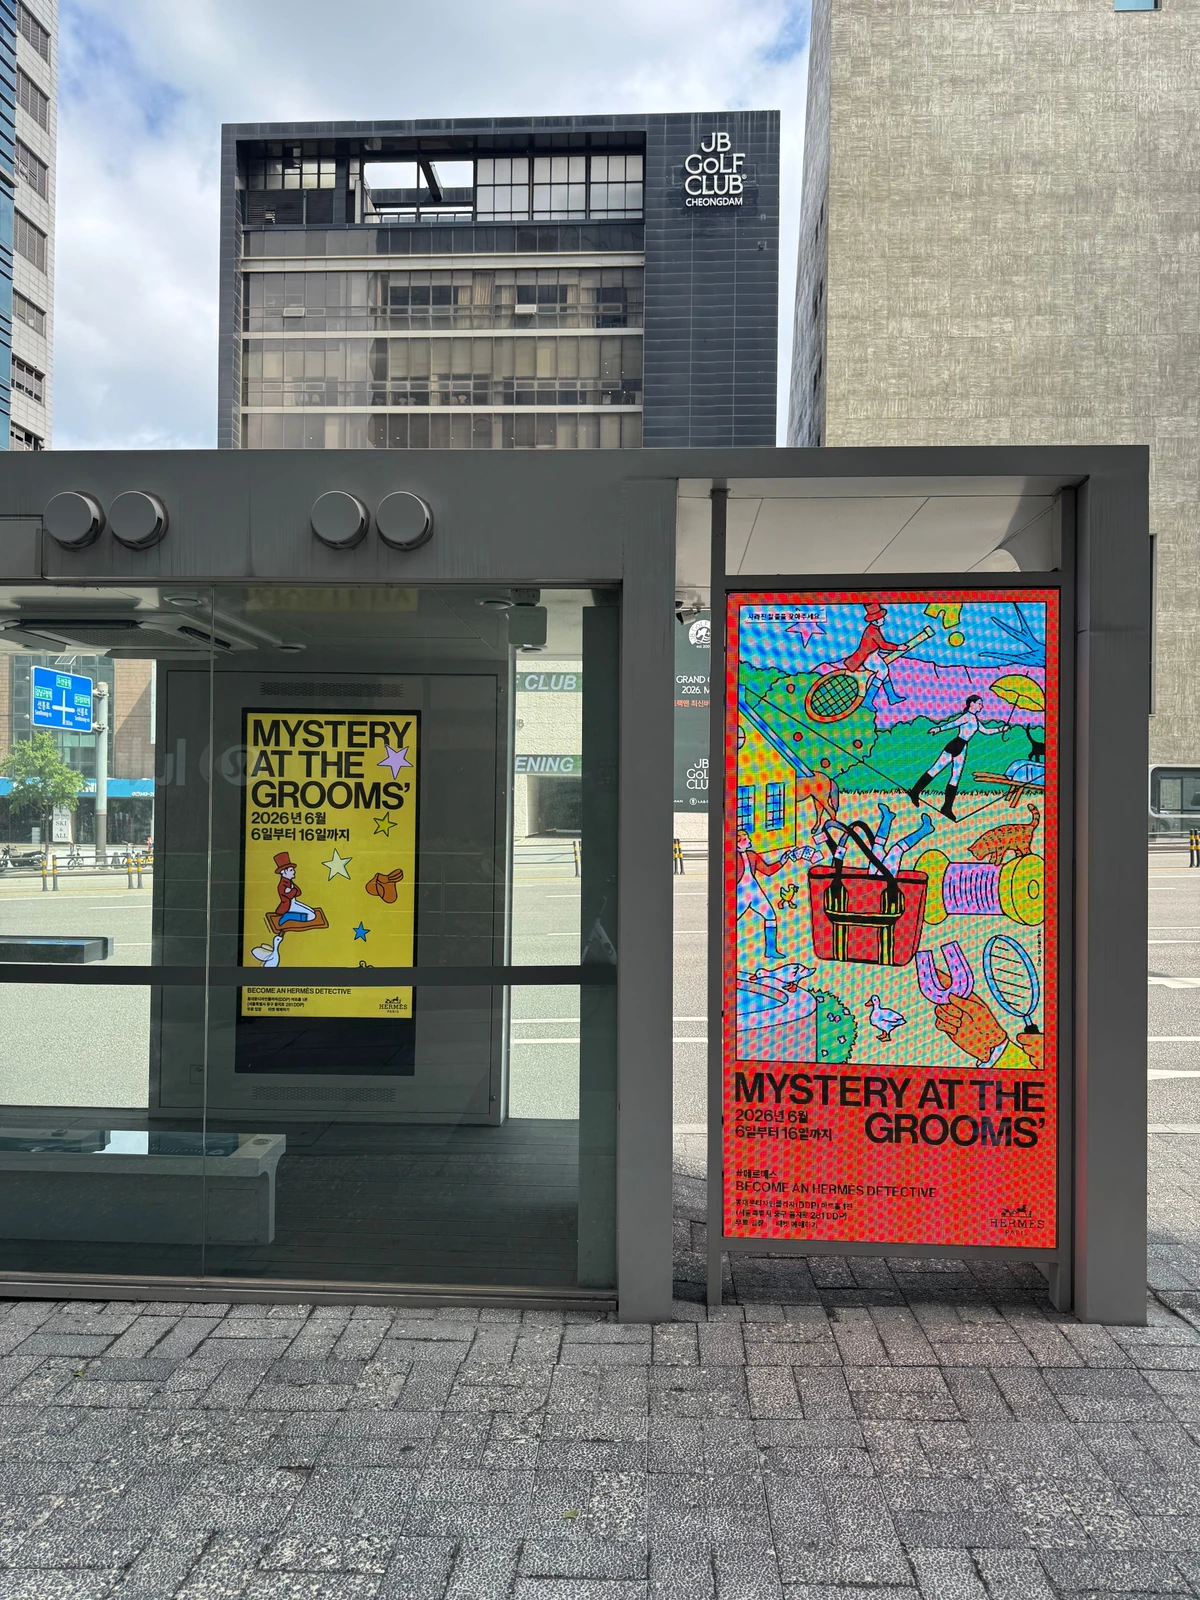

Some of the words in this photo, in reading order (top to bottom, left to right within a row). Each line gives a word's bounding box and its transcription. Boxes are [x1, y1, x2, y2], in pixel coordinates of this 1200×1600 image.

[701, 132, 731, 152] JB
[686, 197, 742, 206] CHEONGDAM
[525, 675, 577, 690] CLUB
[676, 675, 706, 684] GRAND
[681, 686, 702, 694] 2026.
[252, 719, 412, 748] MYSTERY
[251, 750, 293, 778] AT
[298, 751, 365, 779] THE
[694, 758, 709, 768] JB
[251, 811, 302, 825] 2026년
[304, 812, 326, 825] 6월
[251, 828, 296, 841] 6일부터
[298, 828, 350, 842] 16일까지
[247, 987, 275, 995] BECOME
[276, 987, 286, 995] AN
[735, 1071, 912, 1108] MYSTERY
[918, 1079, 963, 1110] AT
[970, 1080, 1045, 1112] THE
[735, 1109, 785, 1123] 2026년
[788, 1110, 808, 1124] 6월
[735, 1125, 780, 1140] 6일부터
[782, 1126, 832, 1141] 16일까지
[736, 1180, 790, 1193] BECOME
[792, 1183, 809, 1194] AN
[866, 1185, 937, 1198] DETECTIVE
